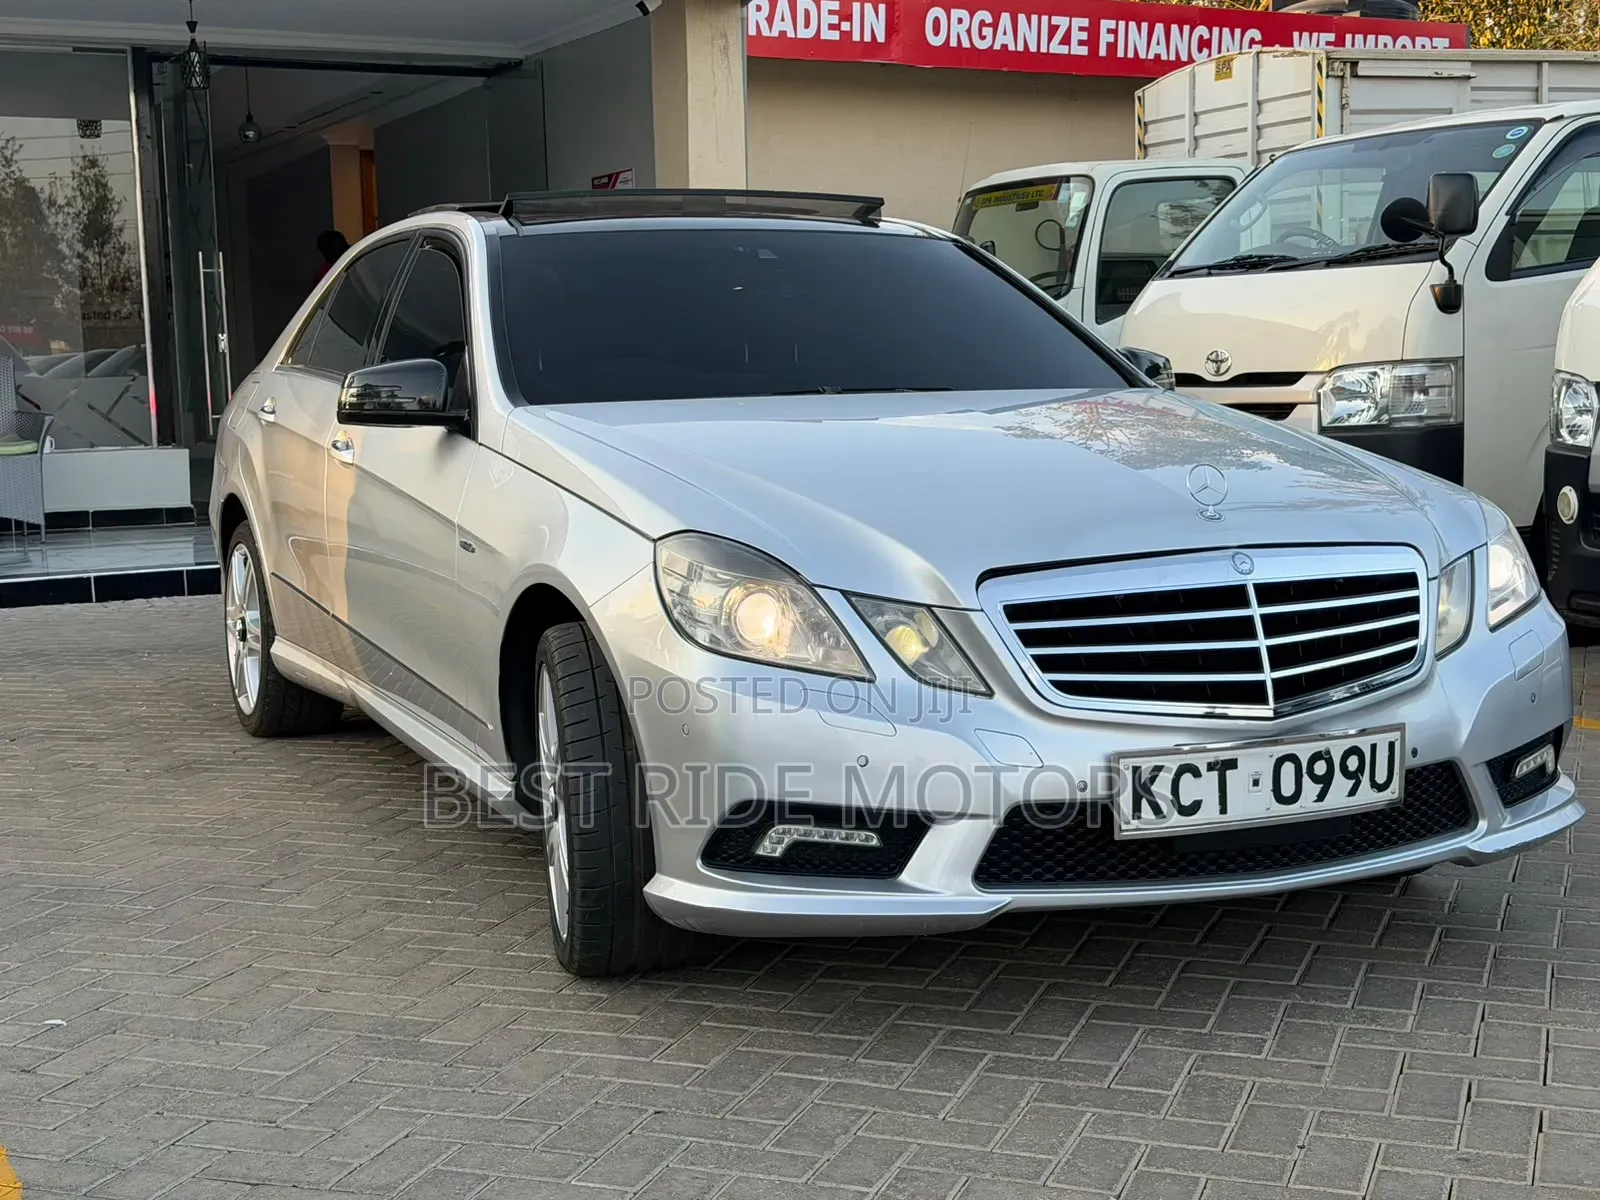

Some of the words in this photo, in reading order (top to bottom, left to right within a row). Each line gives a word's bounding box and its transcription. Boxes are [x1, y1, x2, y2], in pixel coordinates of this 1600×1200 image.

[747, 0, 886, 43] RADE-IN
[924, 7, 1089, 56] ORGANIZE
[1099, 19, 1263, 62] FINANCING
[1215, 62, 1232, 74] SPA
[1131, 757, 1239, 820] KCT
[1270, 741, 1396, 806] 099U
